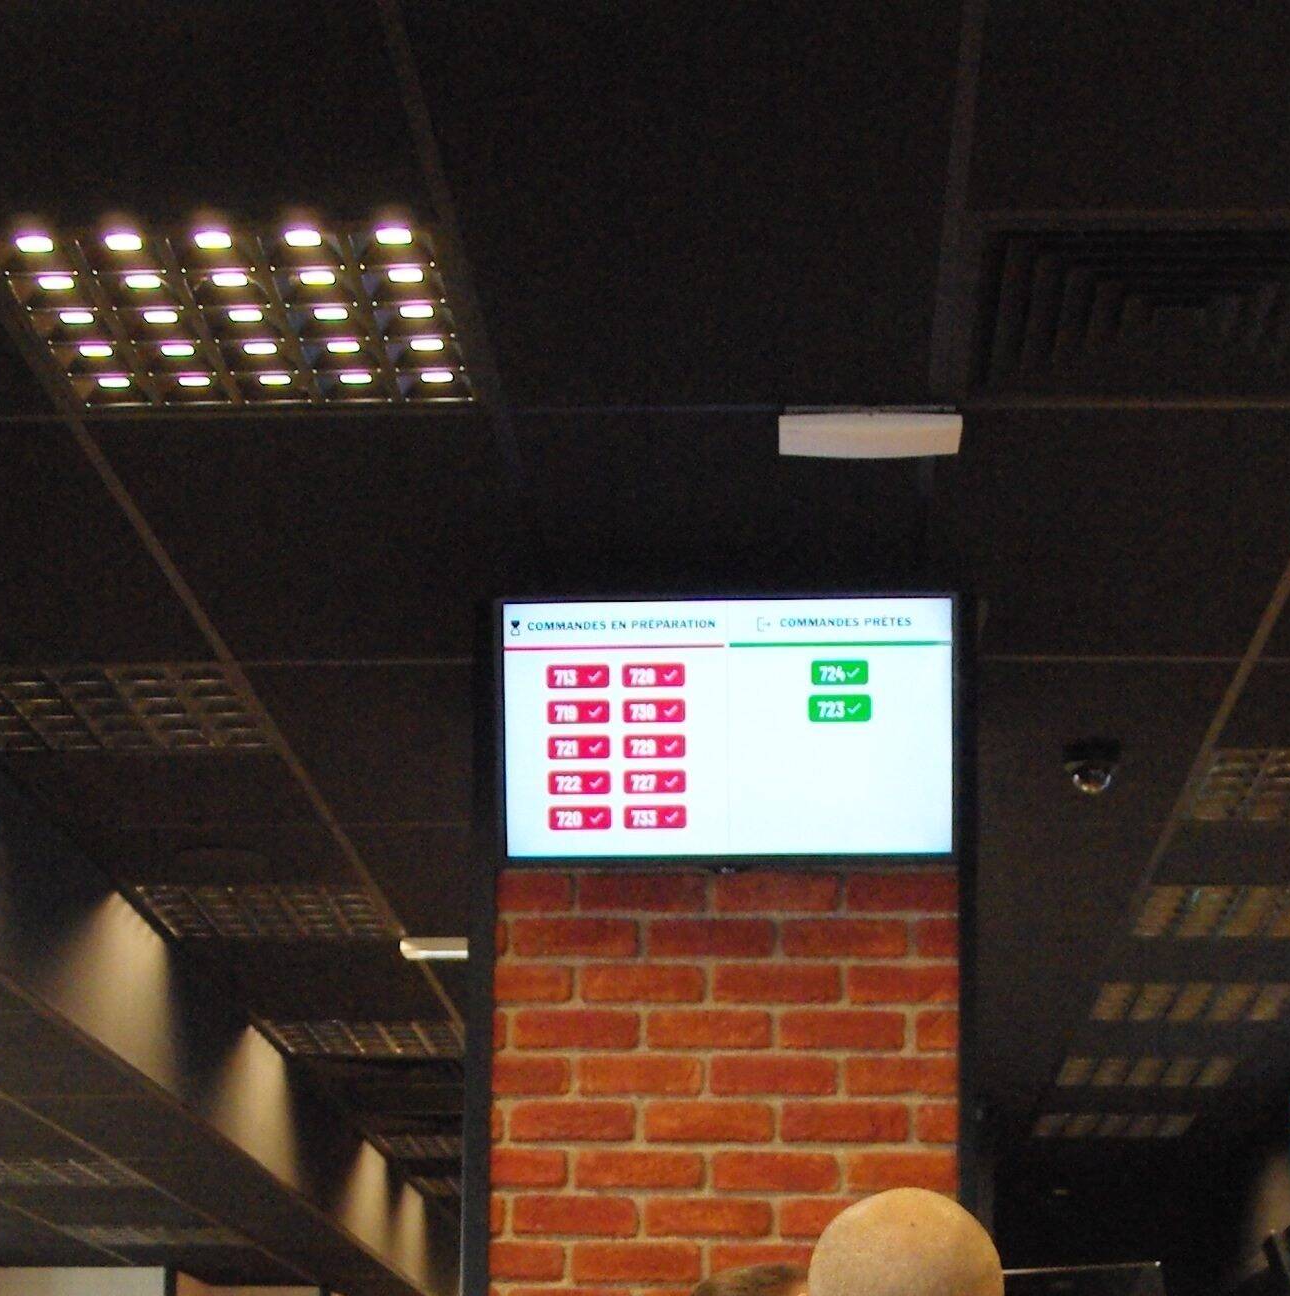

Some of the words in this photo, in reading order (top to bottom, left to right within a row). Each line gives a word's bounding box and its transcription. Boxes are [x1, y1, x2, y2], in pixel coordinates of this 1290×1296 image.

[527, 620, 607, 632] COMMANDES
[611, 620, 627, 631] EN
[631, 618, 716, 630] PRÉPARATION
[779, 616, 860, 628] COMMANDES
[864, 614, 913, 627] PRÊTES
[819, 665, 847, 682] 724
[817, 700, 845, 719] 723
[554, 740, 579, 757] 721
[555, 775, 582, 792] 722
[556, 811, 583, 828] 720
